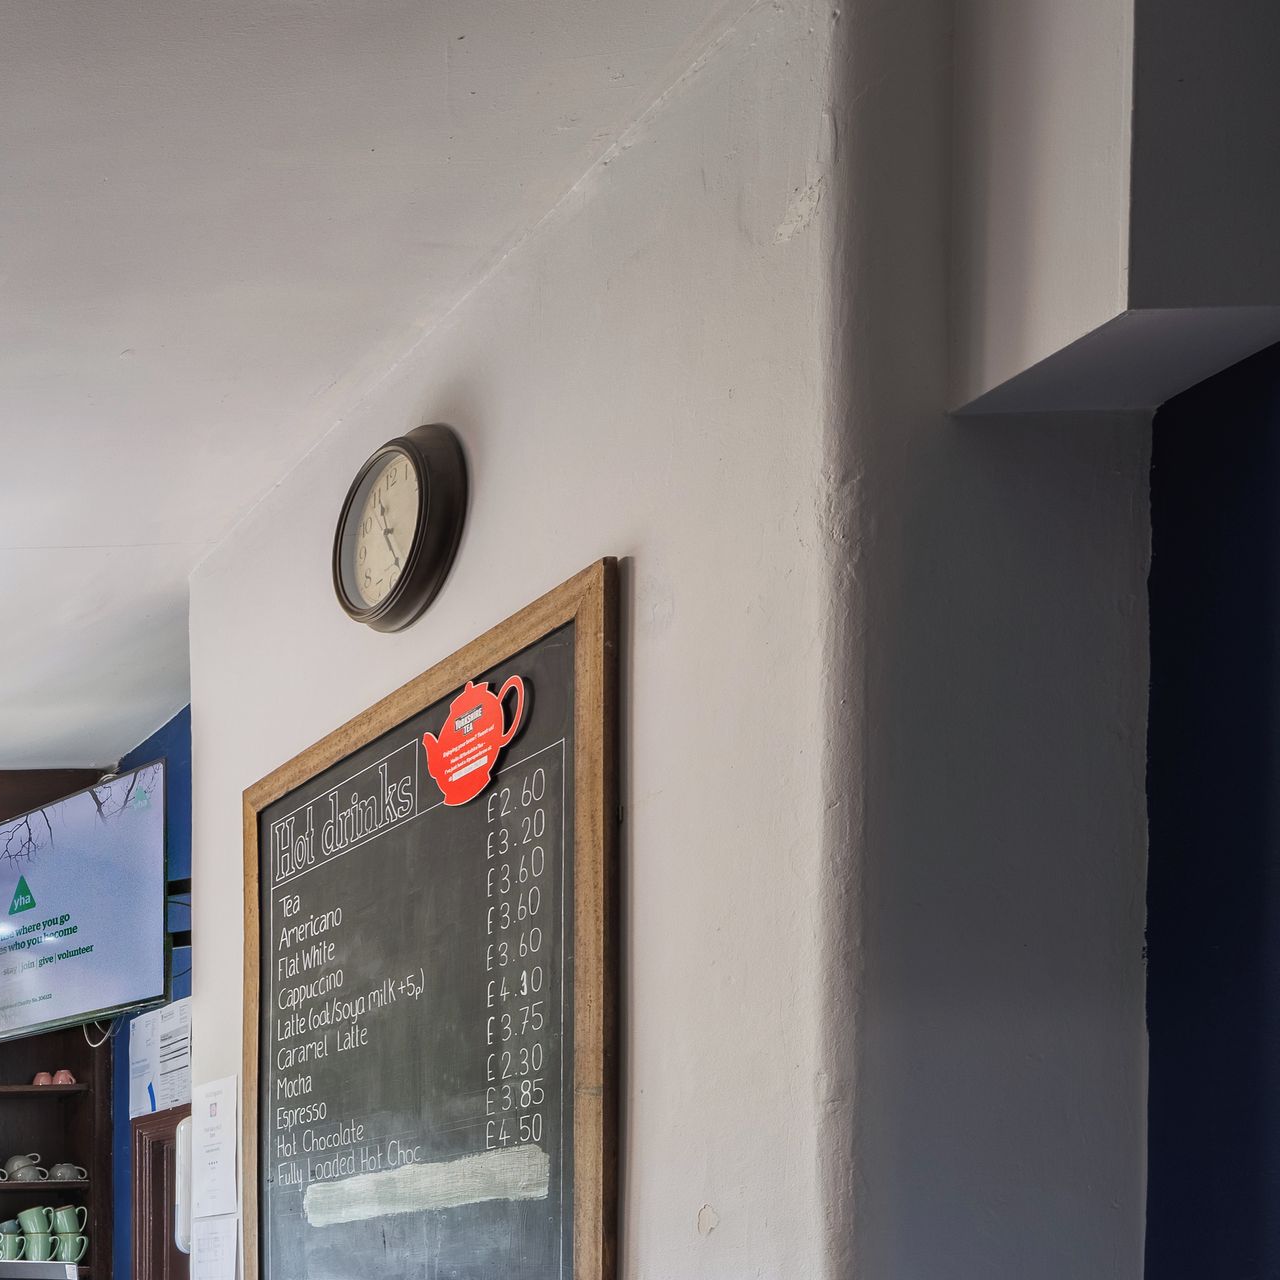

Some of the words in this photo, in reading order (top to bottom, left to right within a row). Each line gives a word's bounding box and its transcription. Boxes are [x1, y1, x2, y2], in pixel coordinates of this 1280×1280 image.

[361, 516, 372, 538] 10
[463, 722, 474, 735] TEA
[487, 768, 546, 824] £2.60
[275, 805, 315, 882] Hot
[321, 762, 414, 856] drinks
[487, 808, 546, 860] £3.20
[487, 846, 545, 898] £3.60
[13, 892, 31, 911] yha
[279, 894, 300, 918] Tea
[487, 886, 541, 935] £3.60
[8, 940, 26, 952] who
[26, 934, 43, 951] you
[15, 923, 42, 937] where
[42, 916, 59, 933] you
[59, 912, 71, 926] go
[279, 907, 343, 951] Americano
[20, 960, 35, 974] join
[38, 955, 54, 968] give
[57, 943, 95, 961] volunteer
[278, 955, 300, 982] Flat
[302, 943, 336, 972] White
[486, 927, 542, 972] £3.60
[278, 969, 344, 1011] Cappuccino
[277, 1013, 307, 1042] Latte
[487, 1001, 544, 1046] £3.75
[277, 1035, 329, 1072] Caramel
[337, 1025, 369, 1053] Latte
[487, 1043, 543, 1082] £2.30
[277, 1073, 313, 1101] Mocha
[486, 1078, 545, 1117] £3.85
[276, 1102, 327, 1133] Espresso
[486, 1113, 543, 1150] £4.50
[277, 1132, 297, 1159] Hot
[302, 1118, 365, 1153] Chocolate
[278, 1161, 303, 1193] Fully
[308, 1149, 356, 1183] Loaded
[360, 1144, 384, 1172] Hot
[387, 1140, 422, 1166] Choc
